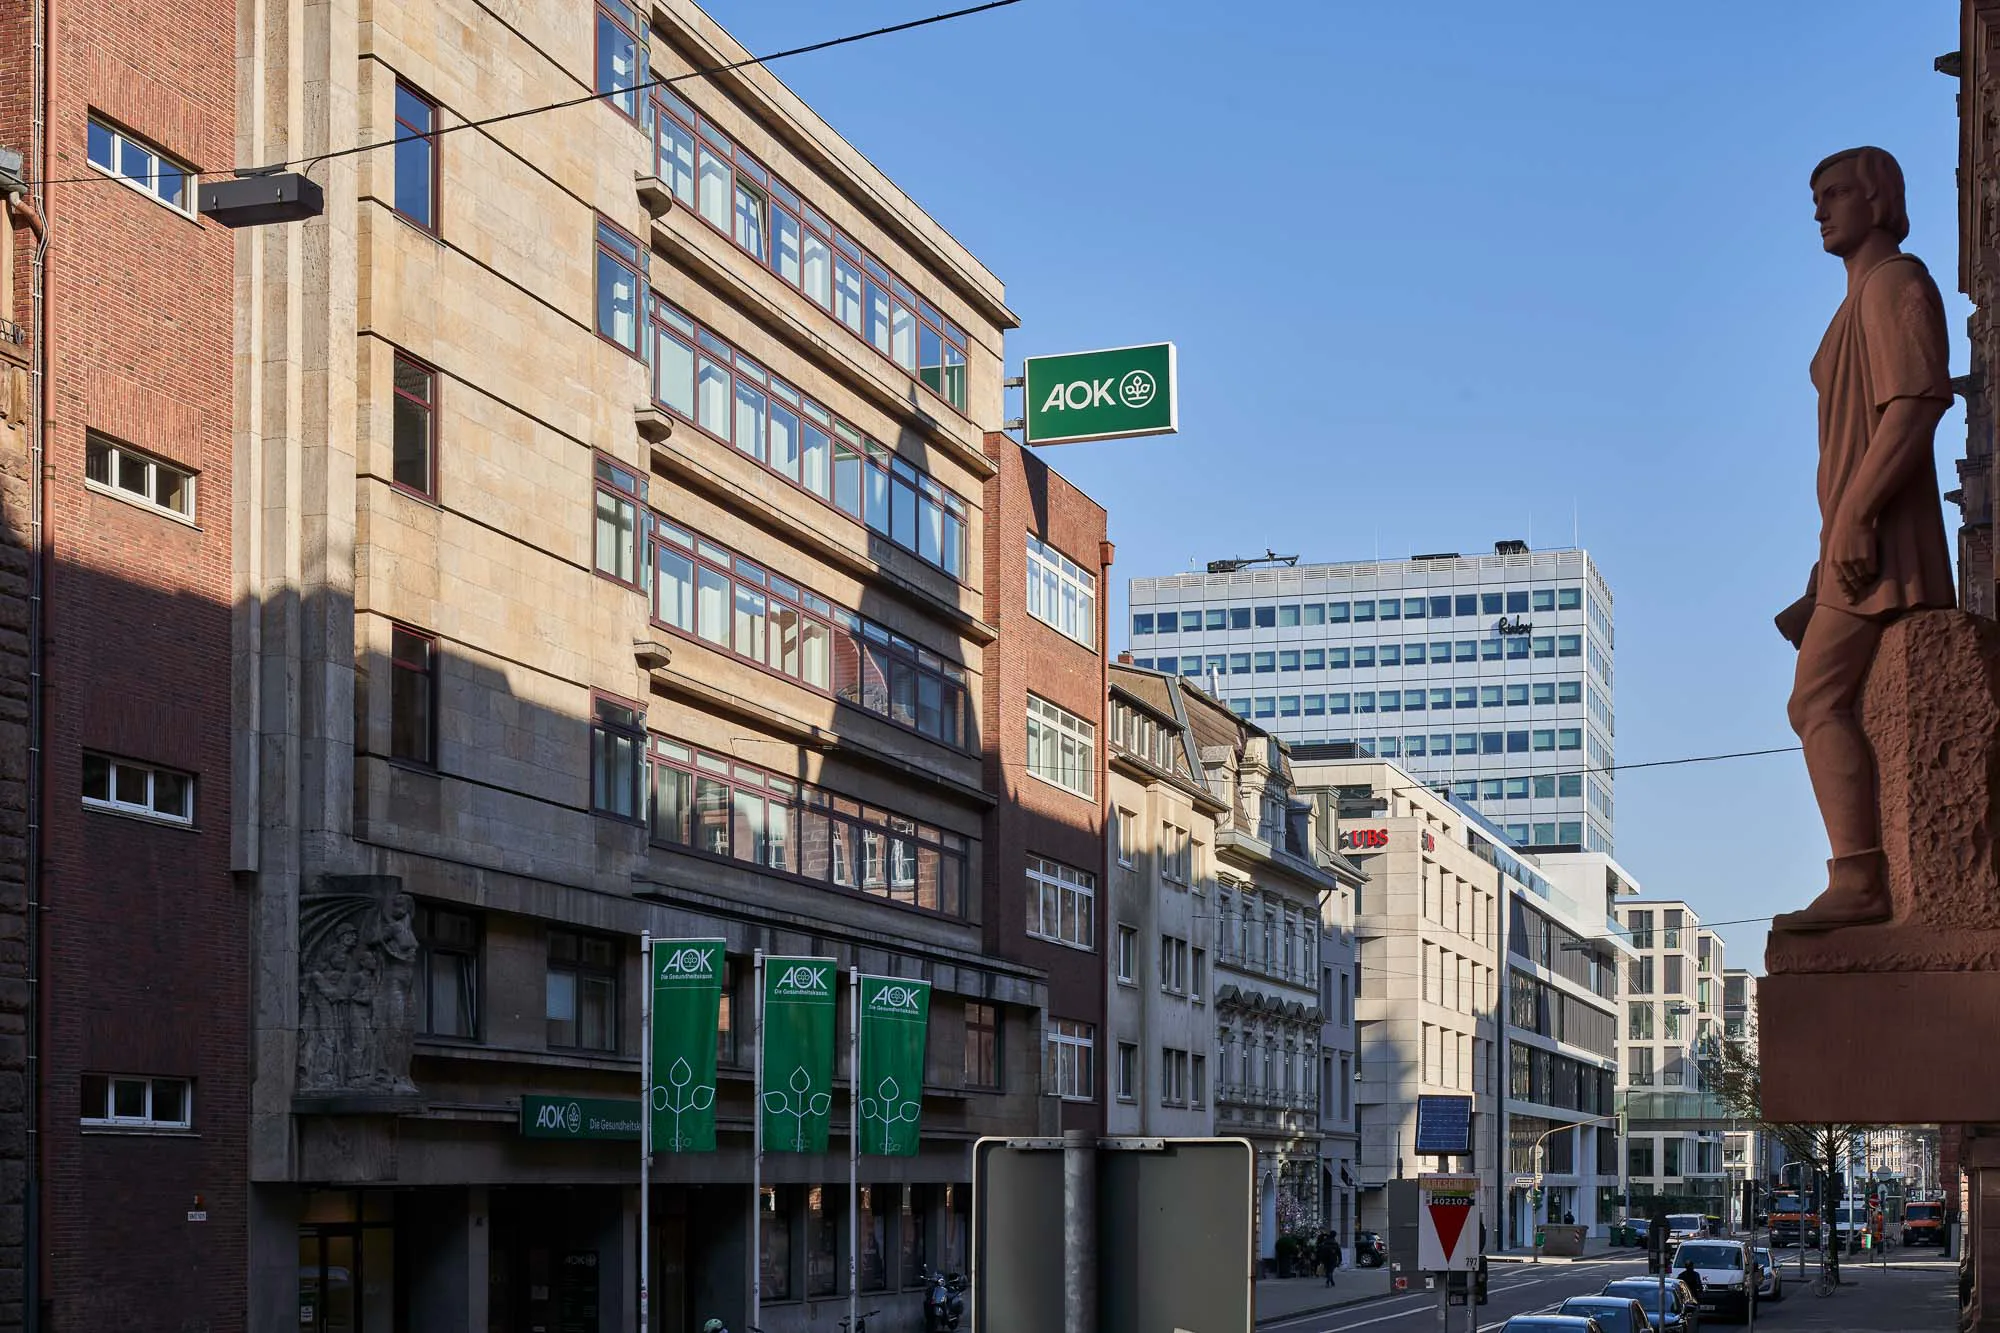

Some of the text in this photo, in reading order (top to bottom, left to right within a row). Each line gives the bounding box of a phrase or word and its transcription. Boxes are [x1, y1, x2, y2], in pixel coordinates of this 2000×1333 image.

[1041, 378, 1116, 412] AOK
[1498, 615, 1532, 639] Ruby
[1352, 829, 1388, 847] UBS
[662, 948, 714, 973] AOK
[776, 966, 828, 989] AOK
[871, 985, 921, 1009] AOK
[535, 1104, 566, 1129] AOK
[589, 1118, 641, 1131] Die Gesundheitsk
[1465, 1257, 1477, 1267] 797
